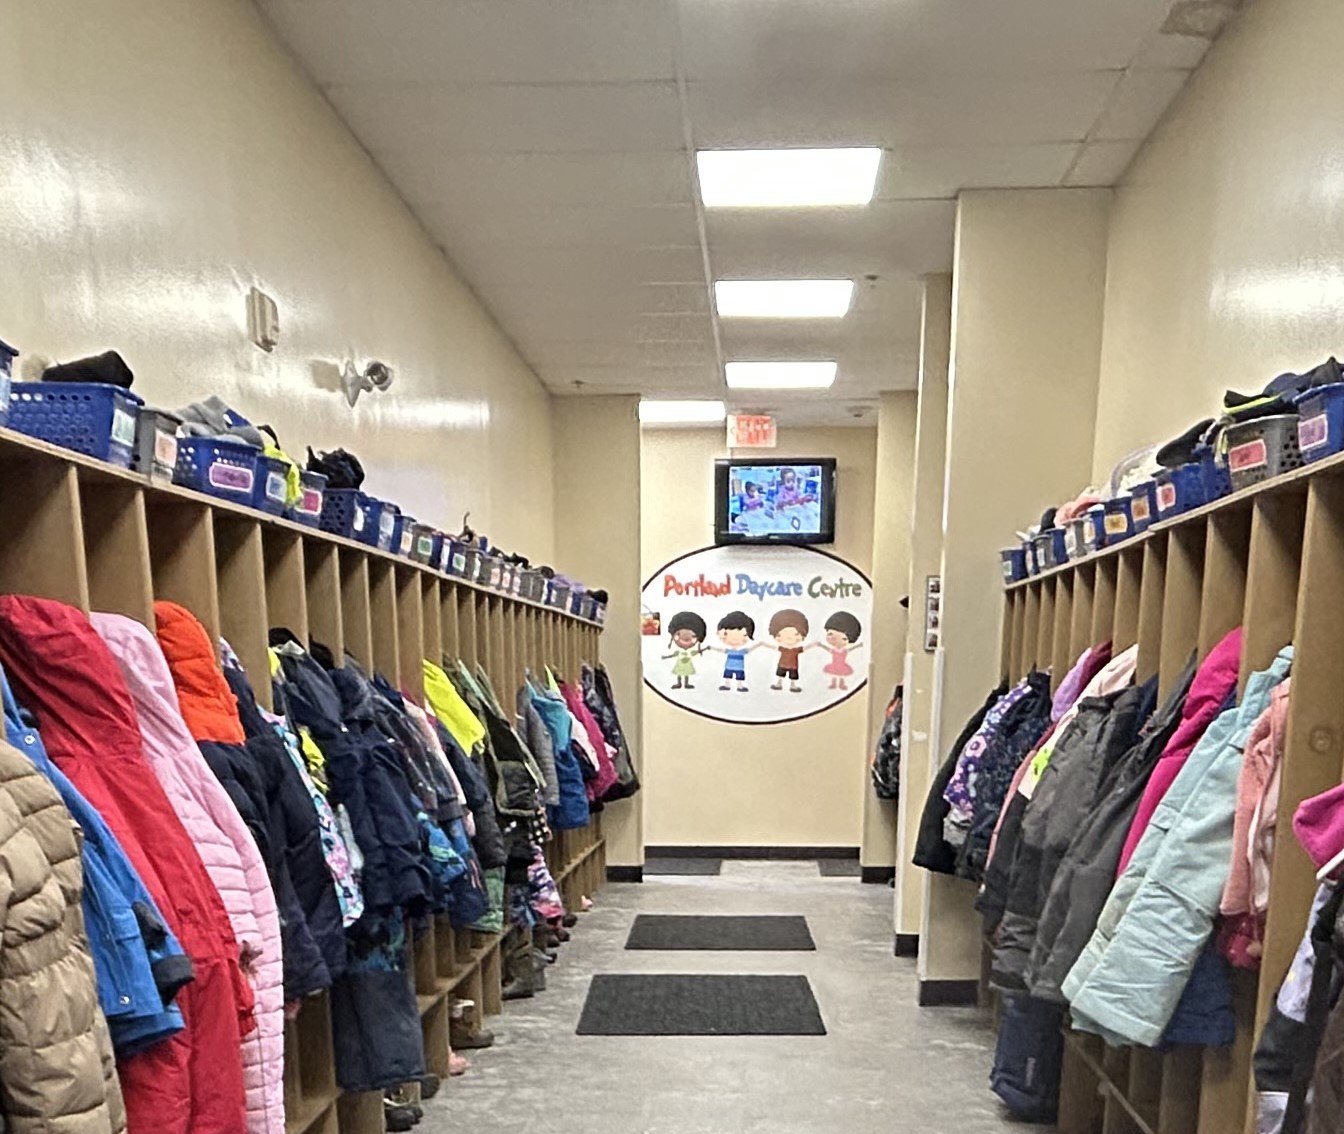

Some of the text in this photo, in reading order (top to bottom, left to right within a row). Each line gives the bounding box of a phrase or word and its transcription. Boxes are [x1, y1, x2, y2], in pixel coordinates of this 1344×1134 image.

[664, 573, 862, 600] Portland Daycare Centre
